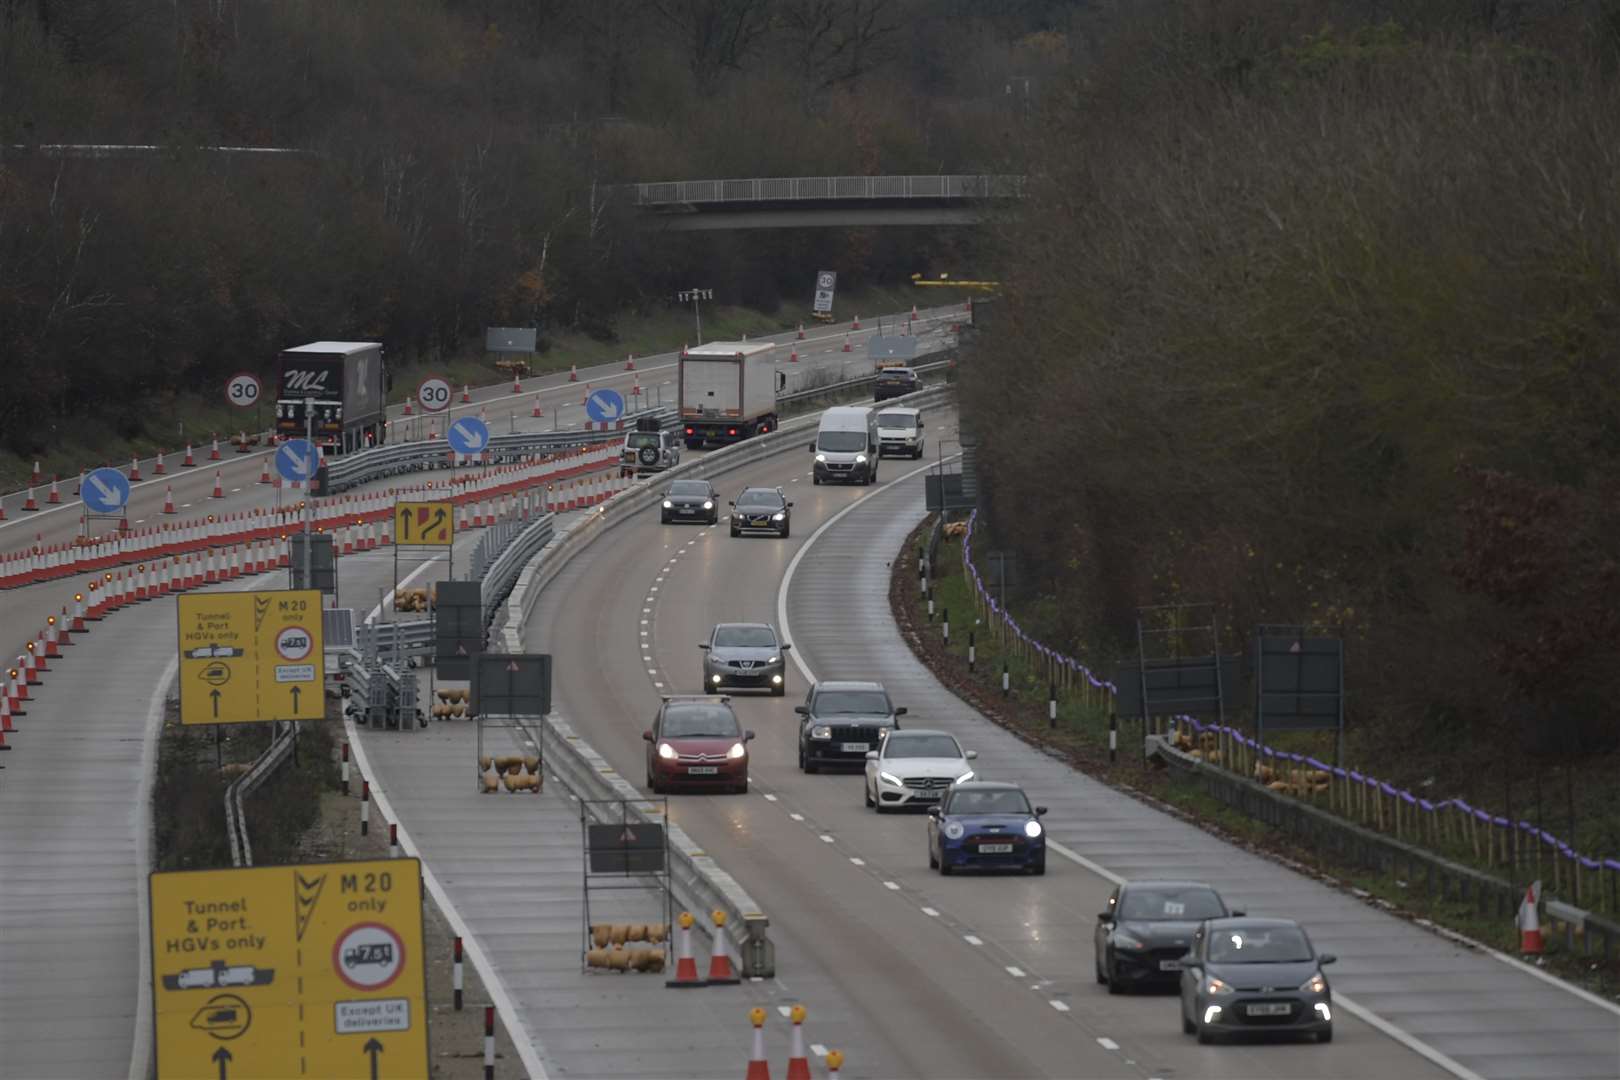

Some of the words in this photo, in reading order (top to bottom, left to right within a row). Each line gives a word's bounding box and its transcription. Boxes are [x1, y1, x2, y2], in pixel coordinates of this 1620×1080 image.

[284, 370, 329, 390] ML
[231, 383, 257, 398] 30
[422, 387, 448, 402] 30
[195, 612, 232, 621] Tunnel
[282, 614, 303, 622] only
[207, 623, 229, 631] Port
[185, 633, 215, 641] HGVs
[217, 632, 239, 641] only
[184, 898, 247, 915] Tunnel
[347, 899, 387, 913] only
[186, 920, 199, 933] &
[207, 916, 246, 931] Port
[166, 937, 220, 953] HGVs
[226, 935, 266, 951] only
[341, 1005, 382, 1018] Except
[384, 1003, 403, 1014] UK
[343, 1015, 401, 1028] deliveries
